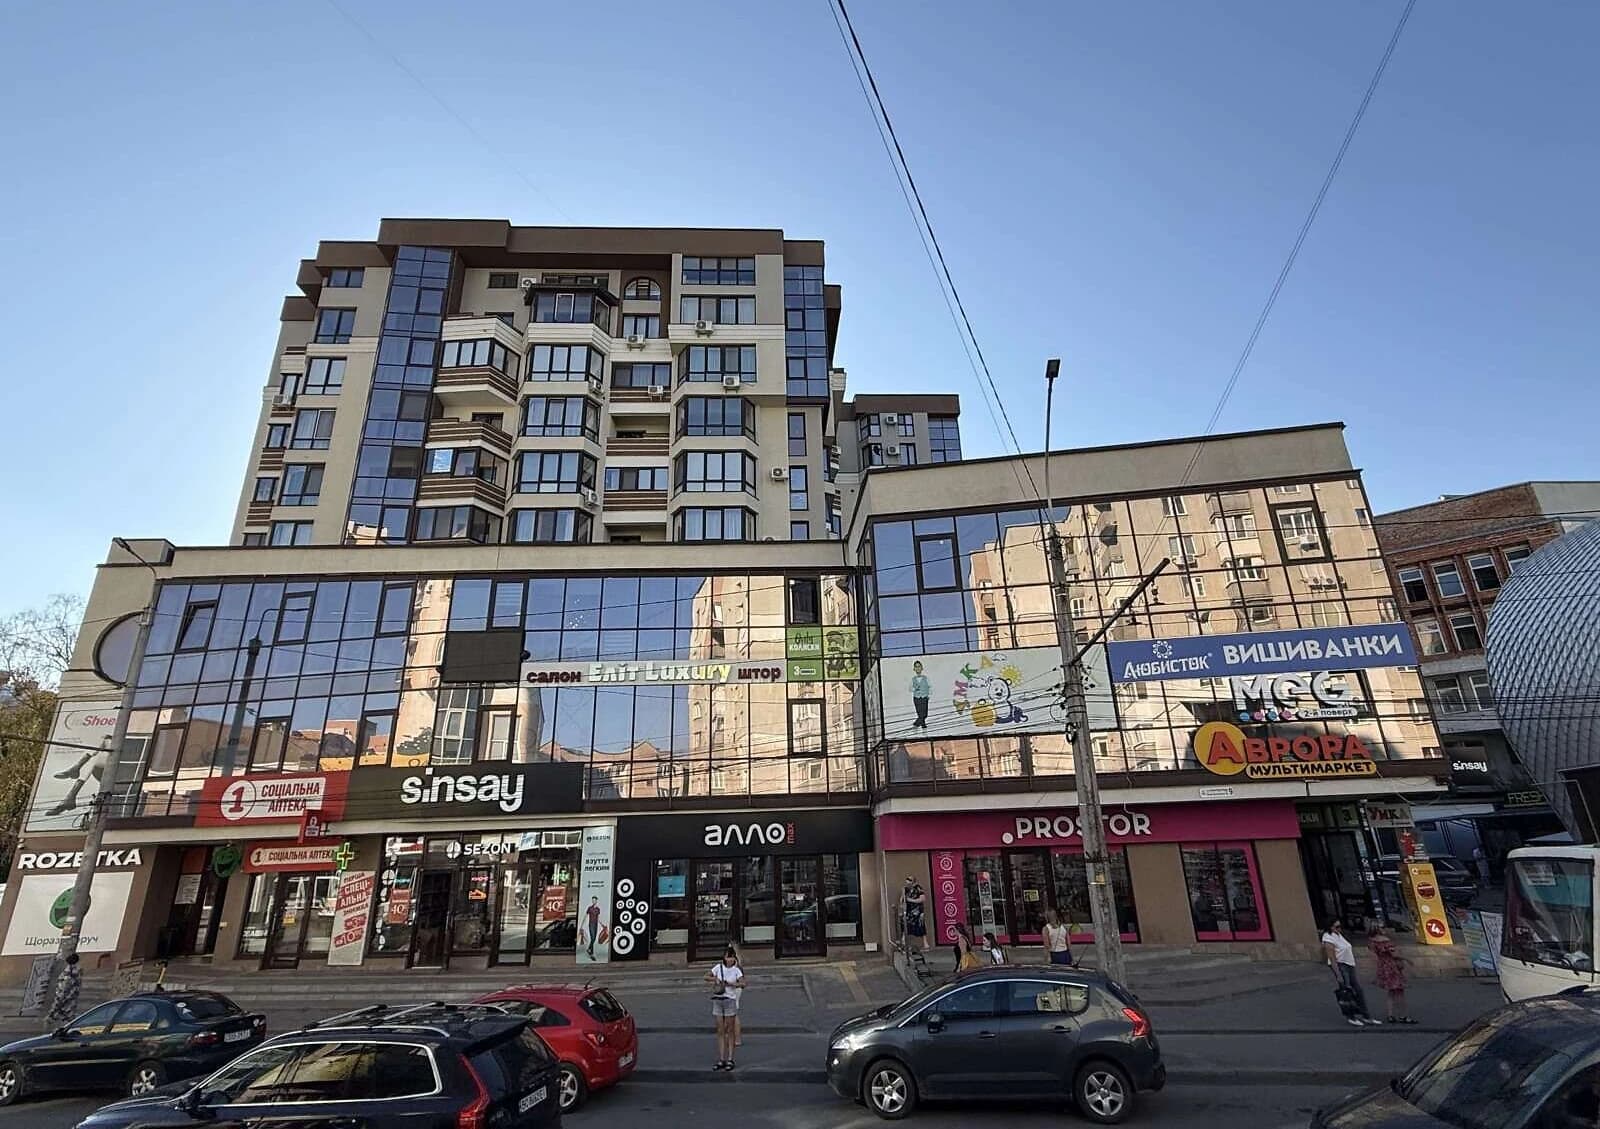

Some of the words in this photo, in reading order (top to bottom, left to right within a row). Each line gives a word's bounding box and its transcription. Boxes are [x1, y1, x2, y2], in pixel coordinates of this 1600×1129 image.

[1223, 634, 1403, 665] ВИШИВАНКИ
[526, 669, 581, 684] салон
[645, 661, 731, 684] Luxury
[737, 666, 782, 681] штор
[1206, 731, 1372, 765] АВРОРА
[1249, 761, 1372, 777] МУЛЬТИМАРКЕТ
[1452, 760, 1488, 773] sinsay
[261, 781, 320, 798] СОЦІАЛЬНА
[400, 768, 525, 812] sinsay
[267, 798, 307, 813] АПТЕКА
[268, 849, 307, 862] СОЦІАЛЬНА
[463, 842, 511, 856] SEZON
